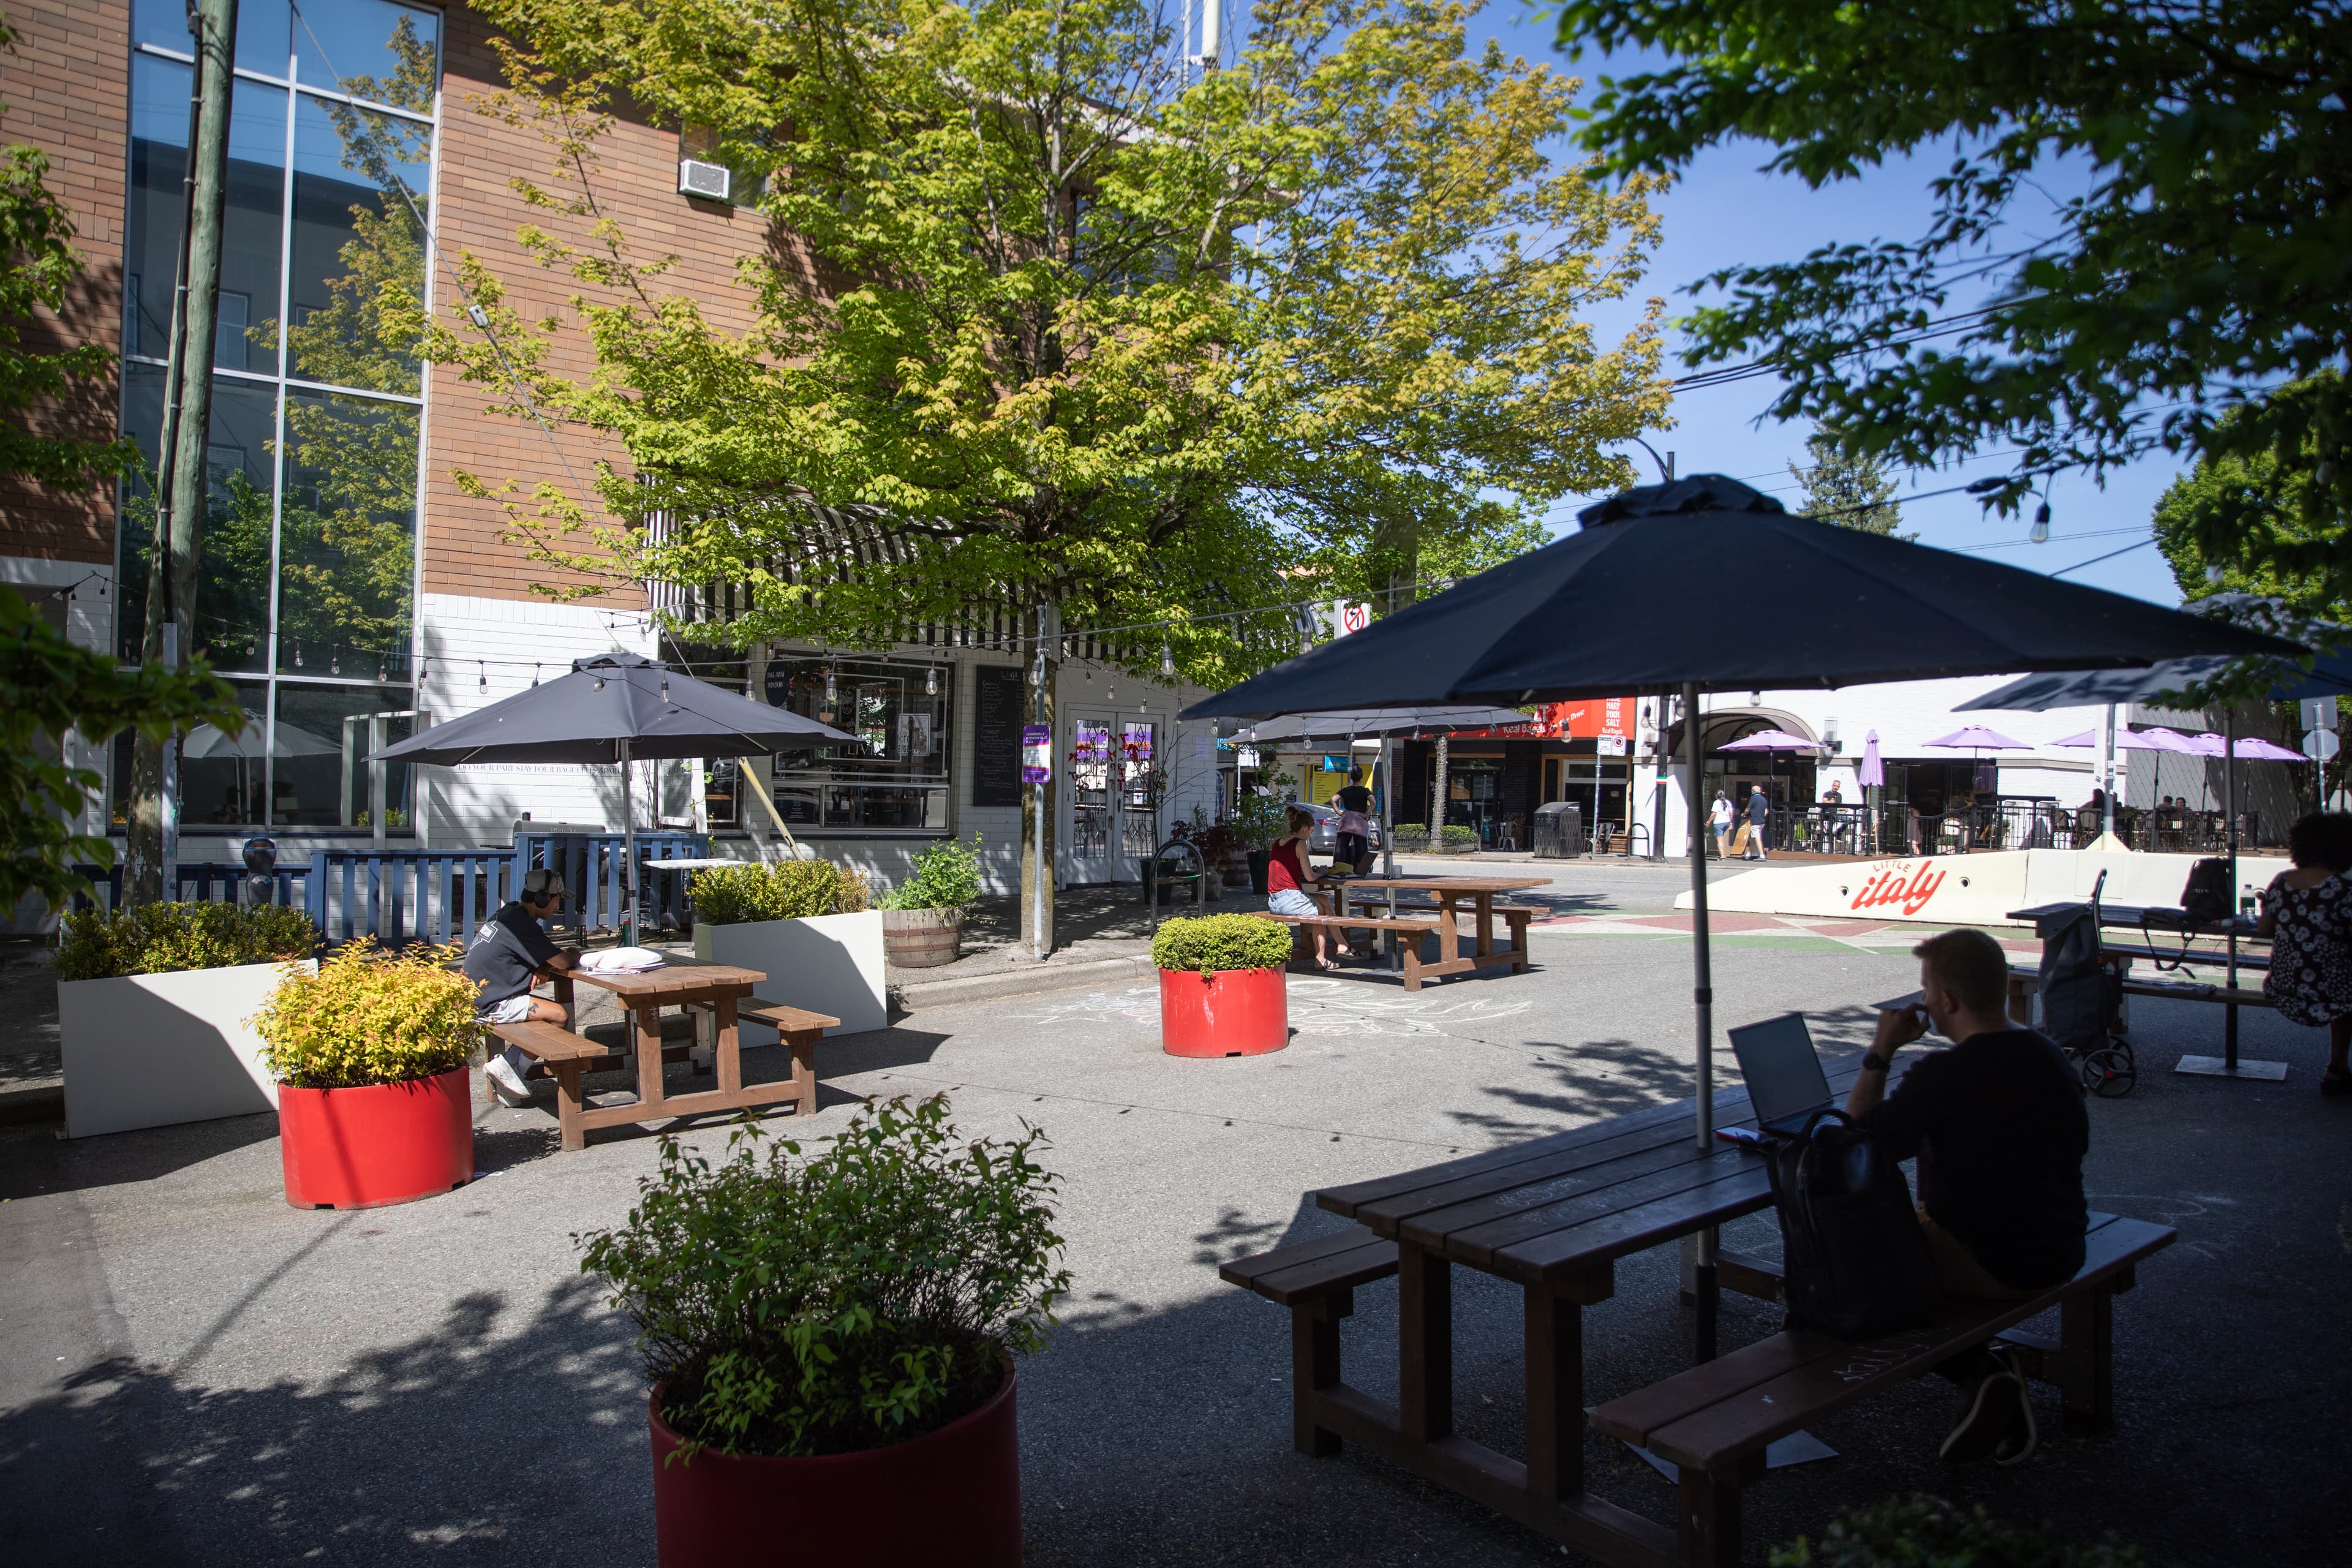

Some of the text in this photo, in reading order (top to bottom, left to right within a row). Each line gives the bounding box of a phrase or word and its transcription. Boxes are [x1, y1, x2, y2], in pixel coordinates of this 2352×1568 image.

[1606, 701, 1621, 710] MARY
[1606, 710, 1621, 718] ROCK
[1504, 725, 1520, 734] Real
[1521, 723, 1547, 735] Bagels
[1570, 709, 1586, 721] Drive
[1606, 718, 1620, 727] SALT
[1872, 860, 1912, 873] LITTLE
[1850, 859, 1947, 916] italy
